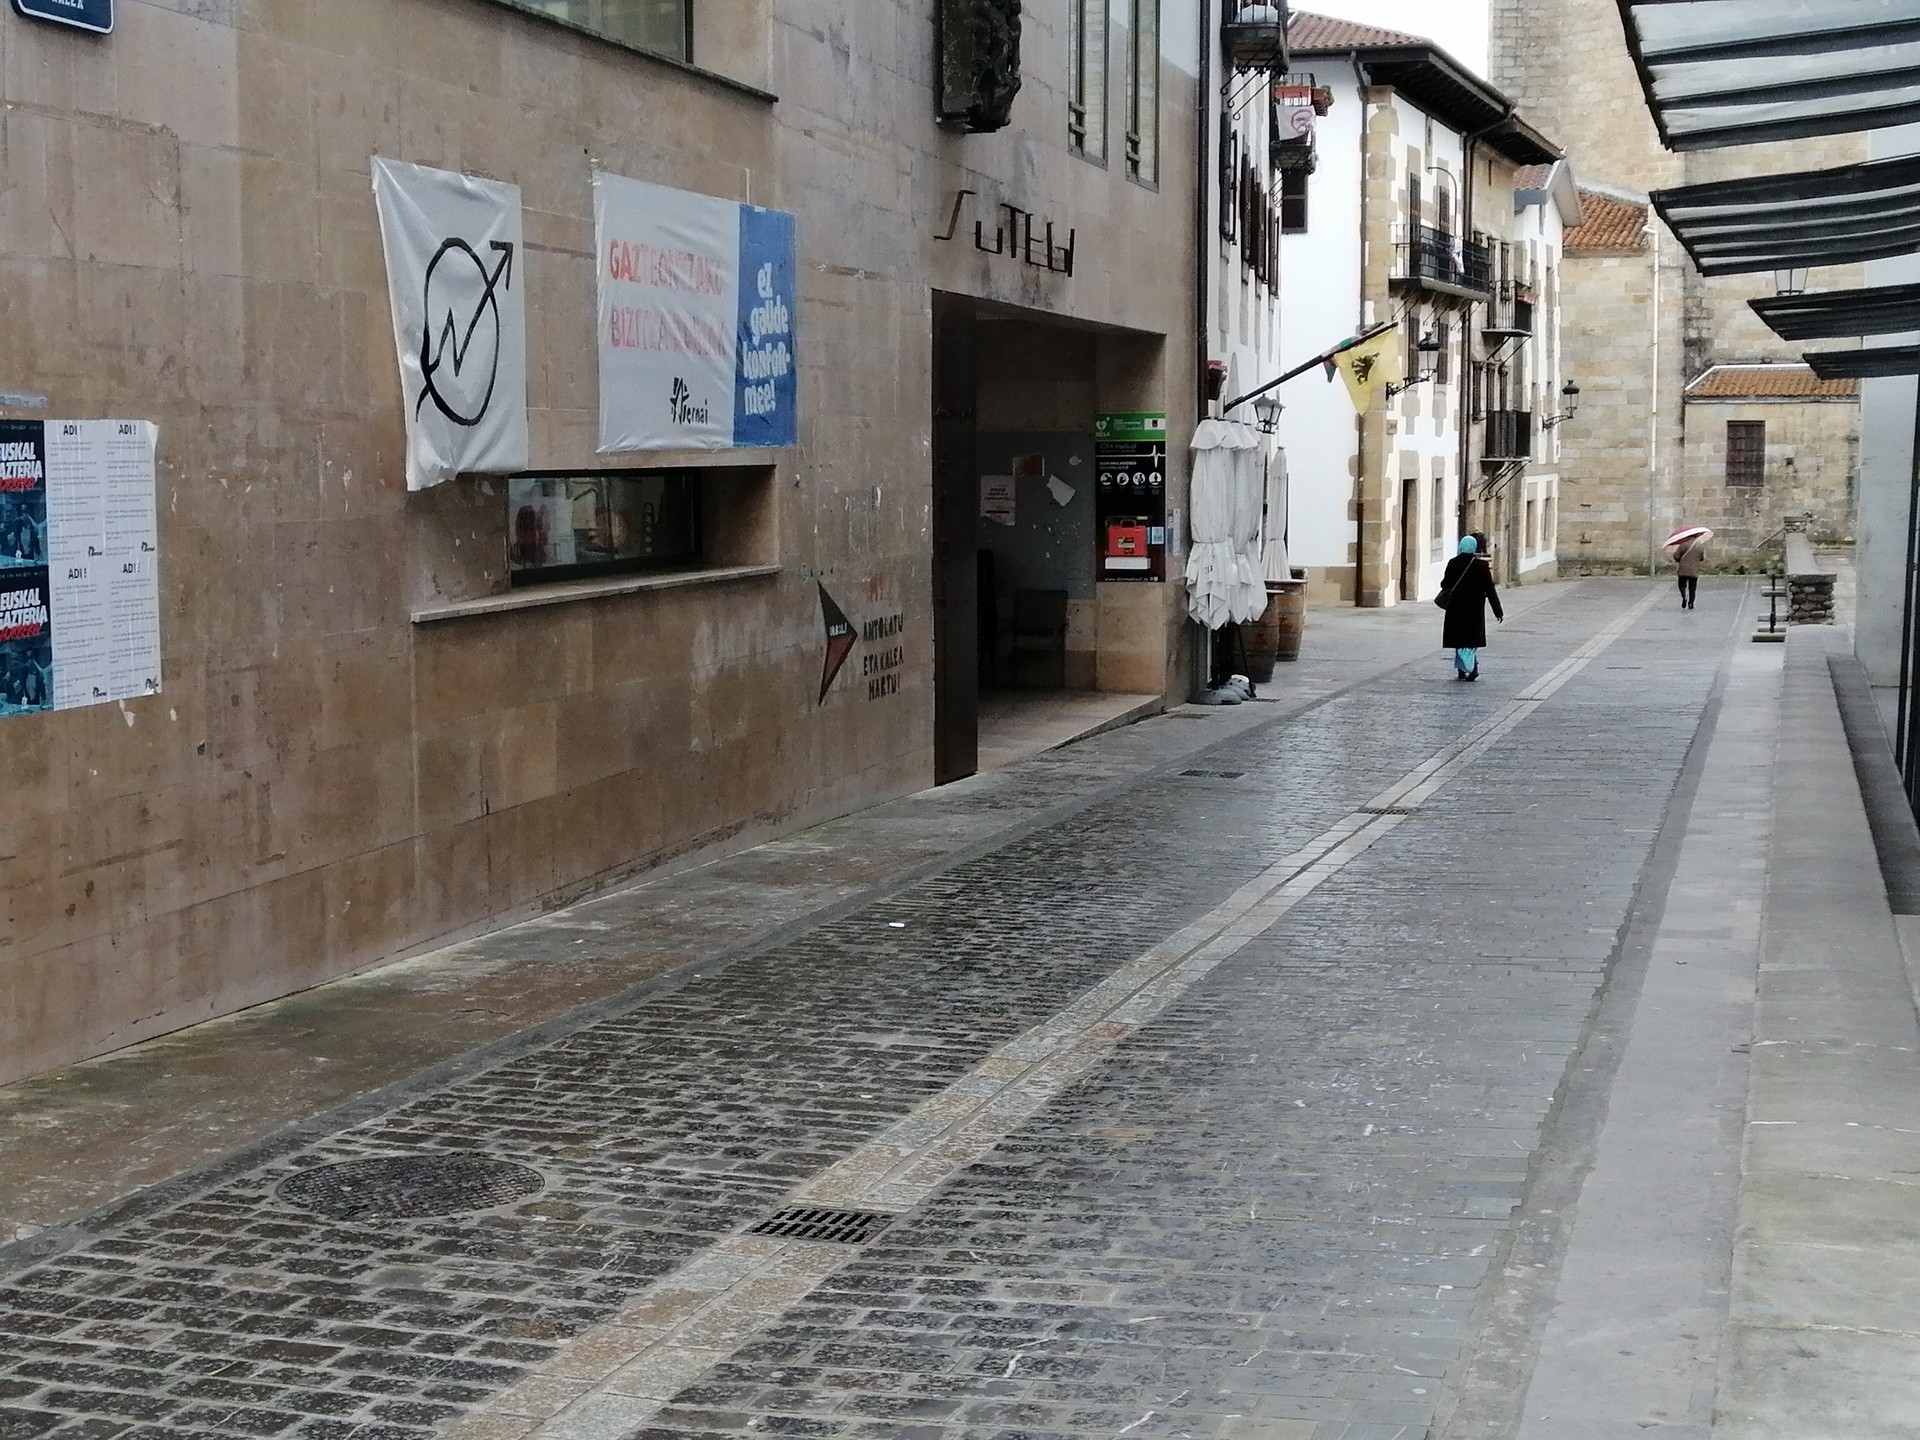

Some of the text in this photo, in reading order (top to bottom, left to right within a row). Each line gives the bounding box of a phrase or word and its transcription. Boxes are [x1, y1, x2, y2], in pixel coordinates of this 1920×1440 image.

[0, 441, 37, 461] USKAL
[0, 459, 43, 482] AZTERIA
[862, 612, 904, 642] ANTOLATU
[862, 653, 880, 677] ETA
